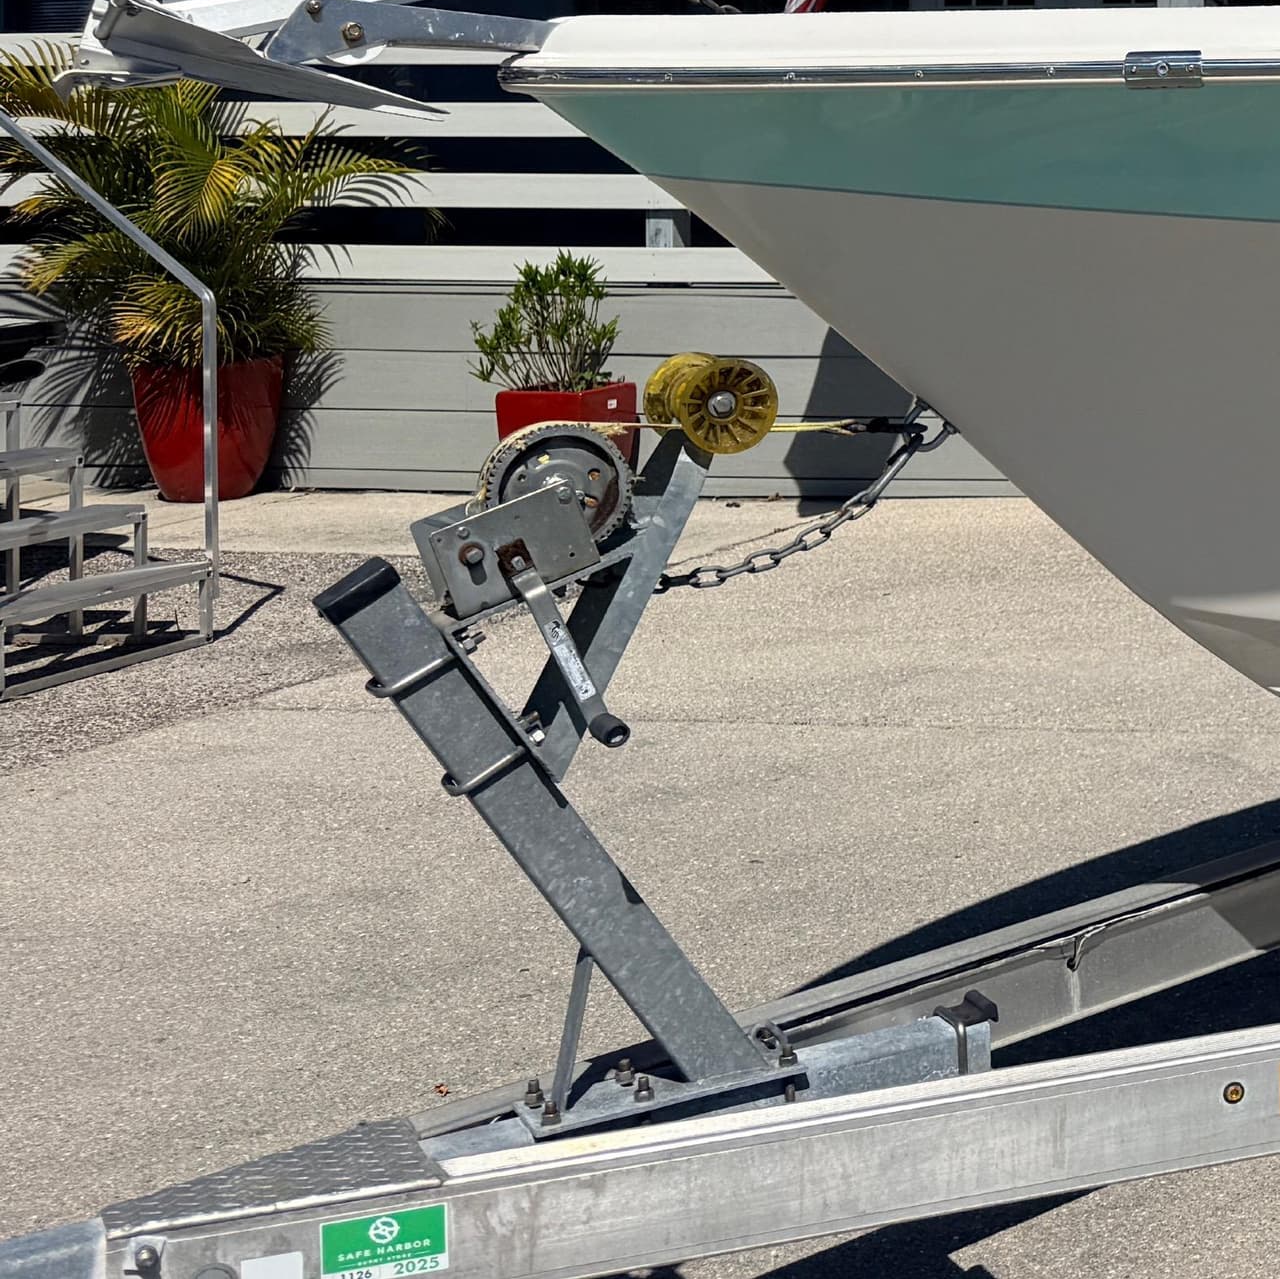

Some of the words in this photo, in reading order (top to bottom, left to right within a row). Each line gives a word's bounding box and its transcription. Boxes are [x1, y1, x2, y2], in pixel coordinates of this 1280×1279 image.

[338, 1250, 370, 1261] SAFE
[376, 1238, 431, 1255] HARBOR
[394, 1257, 439, 1275] 2025
